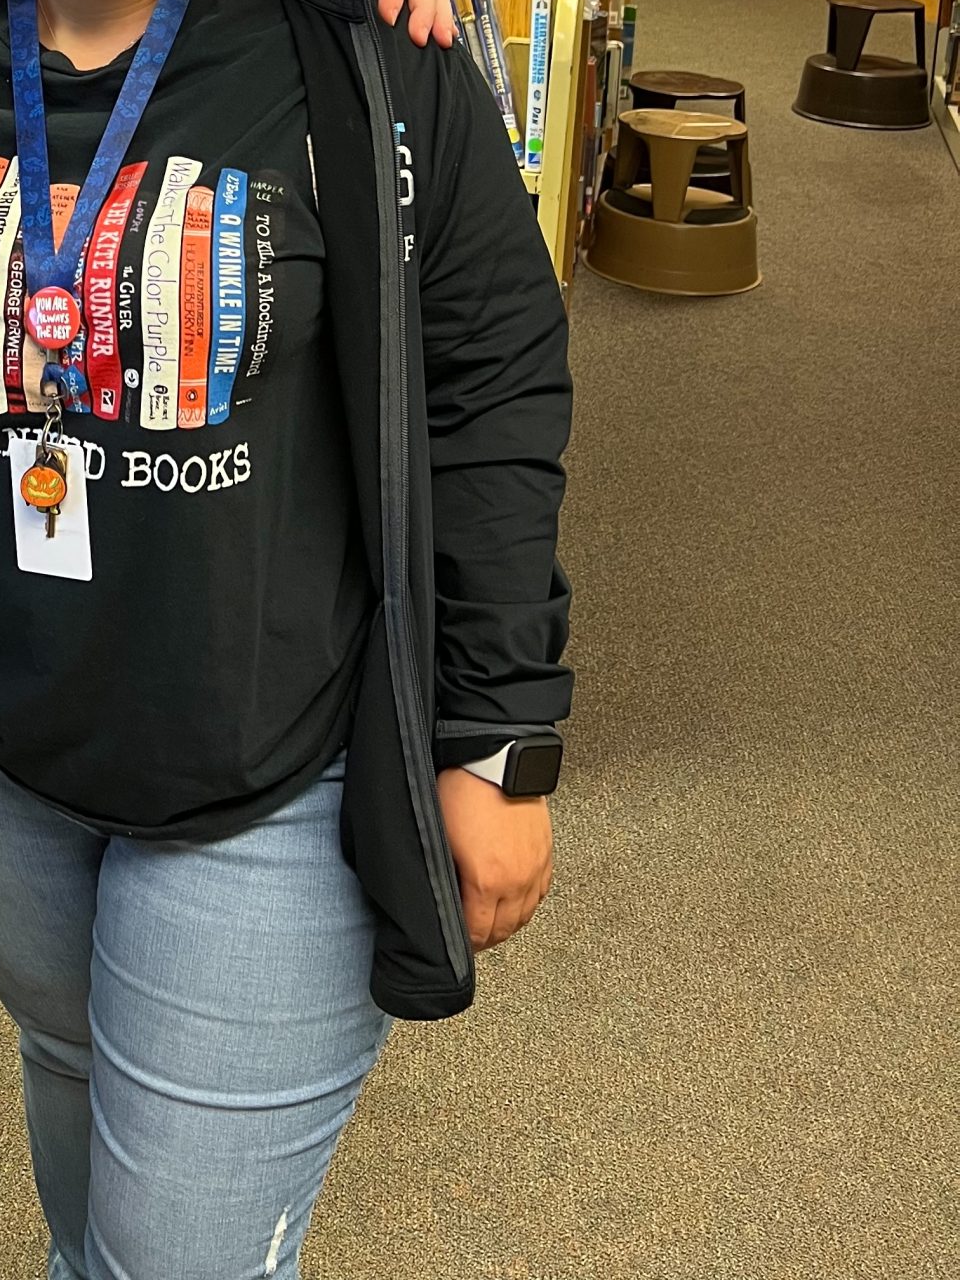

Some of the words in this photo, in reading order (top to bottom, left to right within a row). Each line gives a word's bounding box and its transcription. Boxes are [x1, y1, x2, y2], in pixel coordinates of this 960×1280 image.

[161, 162, 193, 208] Walker
[250, 181, 285, 196] HARPER
[256, 192, 272, 203] LEE
[103, 199, 131, 226] THE
[150, 209, 182, 245] The
[219, 213, 242, 226] A
[255, 214, 271, 237] TO
[92, 230, 120, 270] KITE
[256, 239, 276, 269] KILL
[145, 249, 178, 306] Color
[183, 243, 196, 332] HUCKLEBERRY
[218, 231, 243, 308] WRINKLE
[257, 272, 272, 286] A
[7, 260, 24, 316] GEORGE
[52, 296, 68, 311] ARE
[119, 281, 136, 331] GIVER
[35, 324, 52, 339] THE
[52, 324, 72, 340] BEST
[36, 312, 70, 325] ALWAYS
[88, 277, 114, 358] RUNNER
[219, 314, 243, 332] IN
[246, 287, 275, 377] Mockingbird
[6, 320, 21, 375] ORWELL
[143, 311, 177, 373] Purple
[183, 332, 196, 357] FINN
[214, 336, 241, 374] TIME
[209, 402, 228, 416] Ariel
[121, 441, 252, 494] BOOKS
